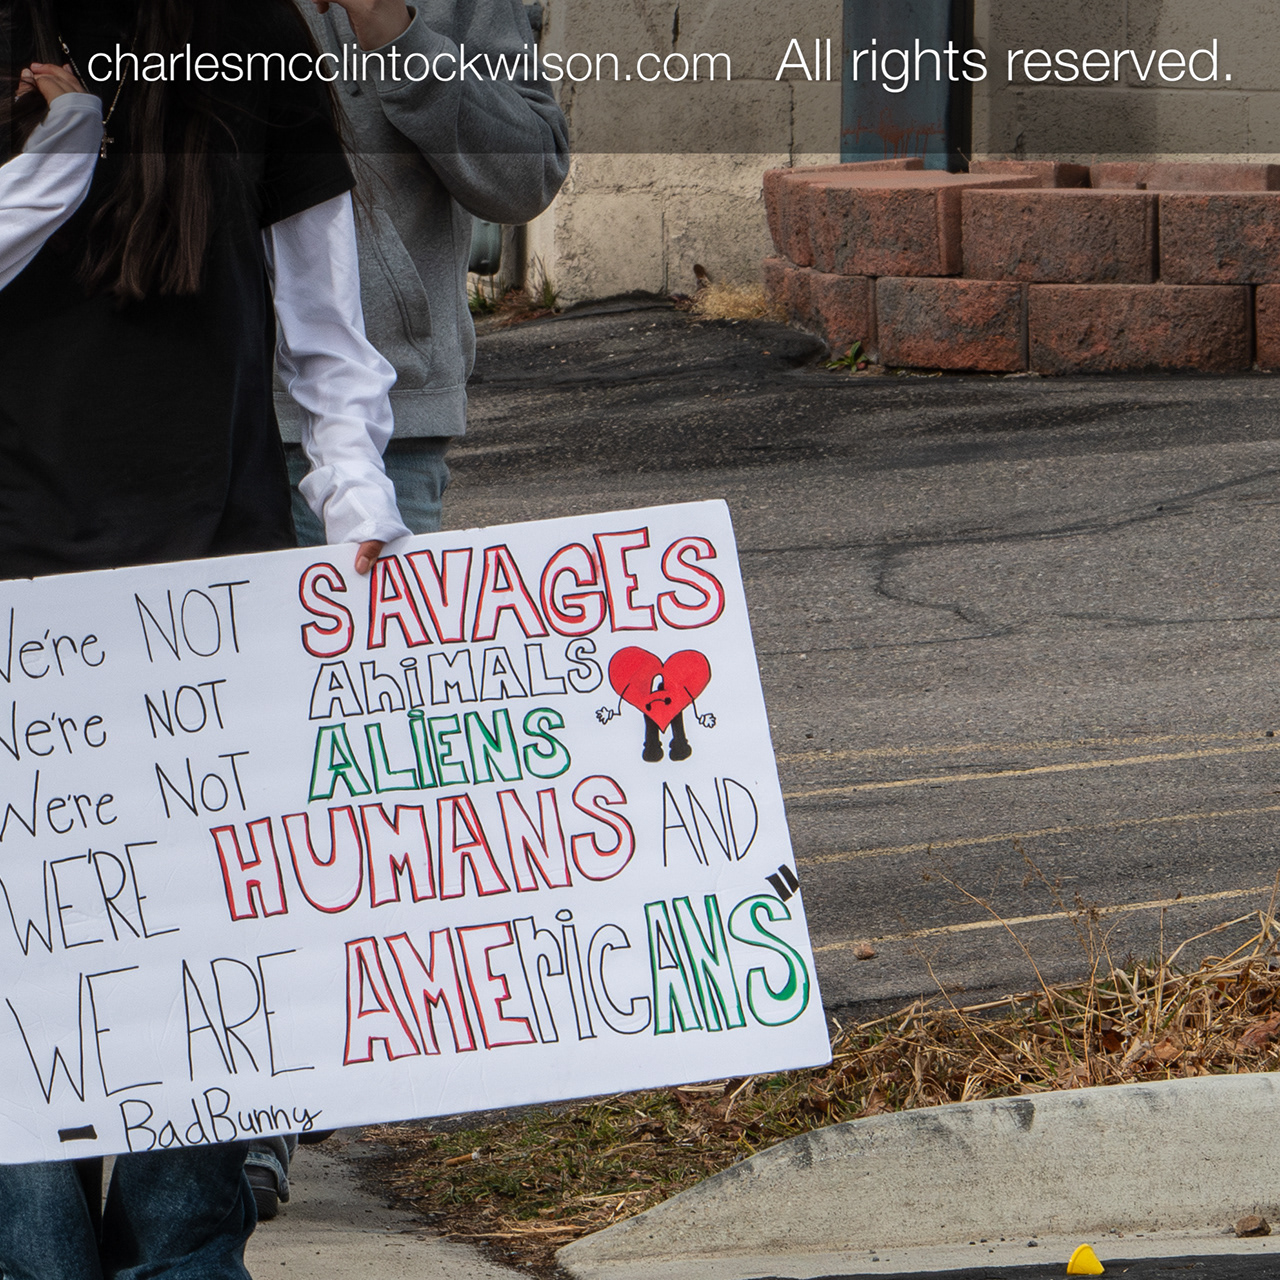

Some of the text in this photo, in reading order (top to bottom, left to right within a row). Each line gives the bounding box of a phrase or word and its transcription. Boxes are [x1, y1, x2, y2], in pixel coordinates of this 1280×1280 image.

[134, 579, 250, 664] NOT
[299, 526, 726, 658] SAVAGES
[147, 679, 228, 737] NOT
[211, 774, 635, 922] HUMANS
[661, 776, 760, 867] AND
[6, 966, 163, 1104] WE
[182, 949, 315, 1082] ARE
